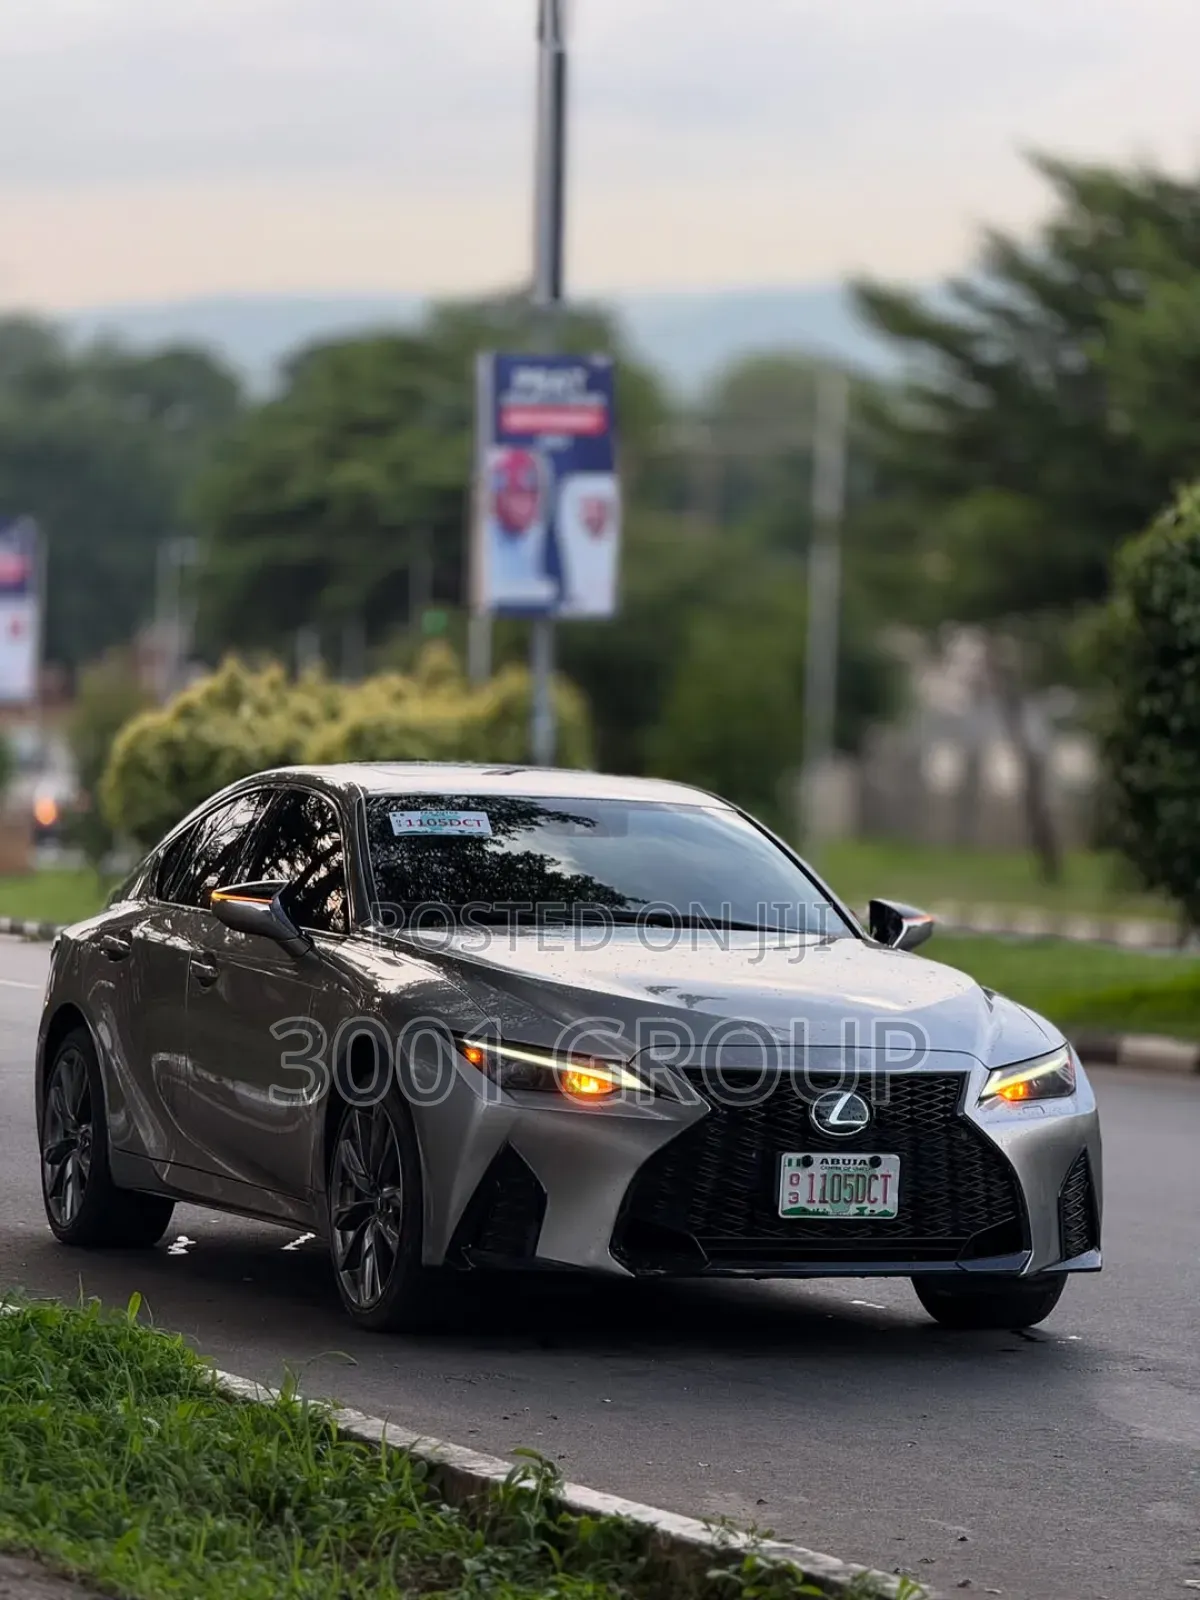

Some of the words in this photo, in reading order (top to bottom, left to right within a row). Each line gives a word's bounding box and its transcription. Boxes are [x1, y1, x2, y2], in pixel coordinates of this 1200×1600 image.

[406, 818, 484, 828] 1105DCT
[820, 1158, 868, 1166] ABUJA
[806, 1173, 891, 1204] 1105DCT
